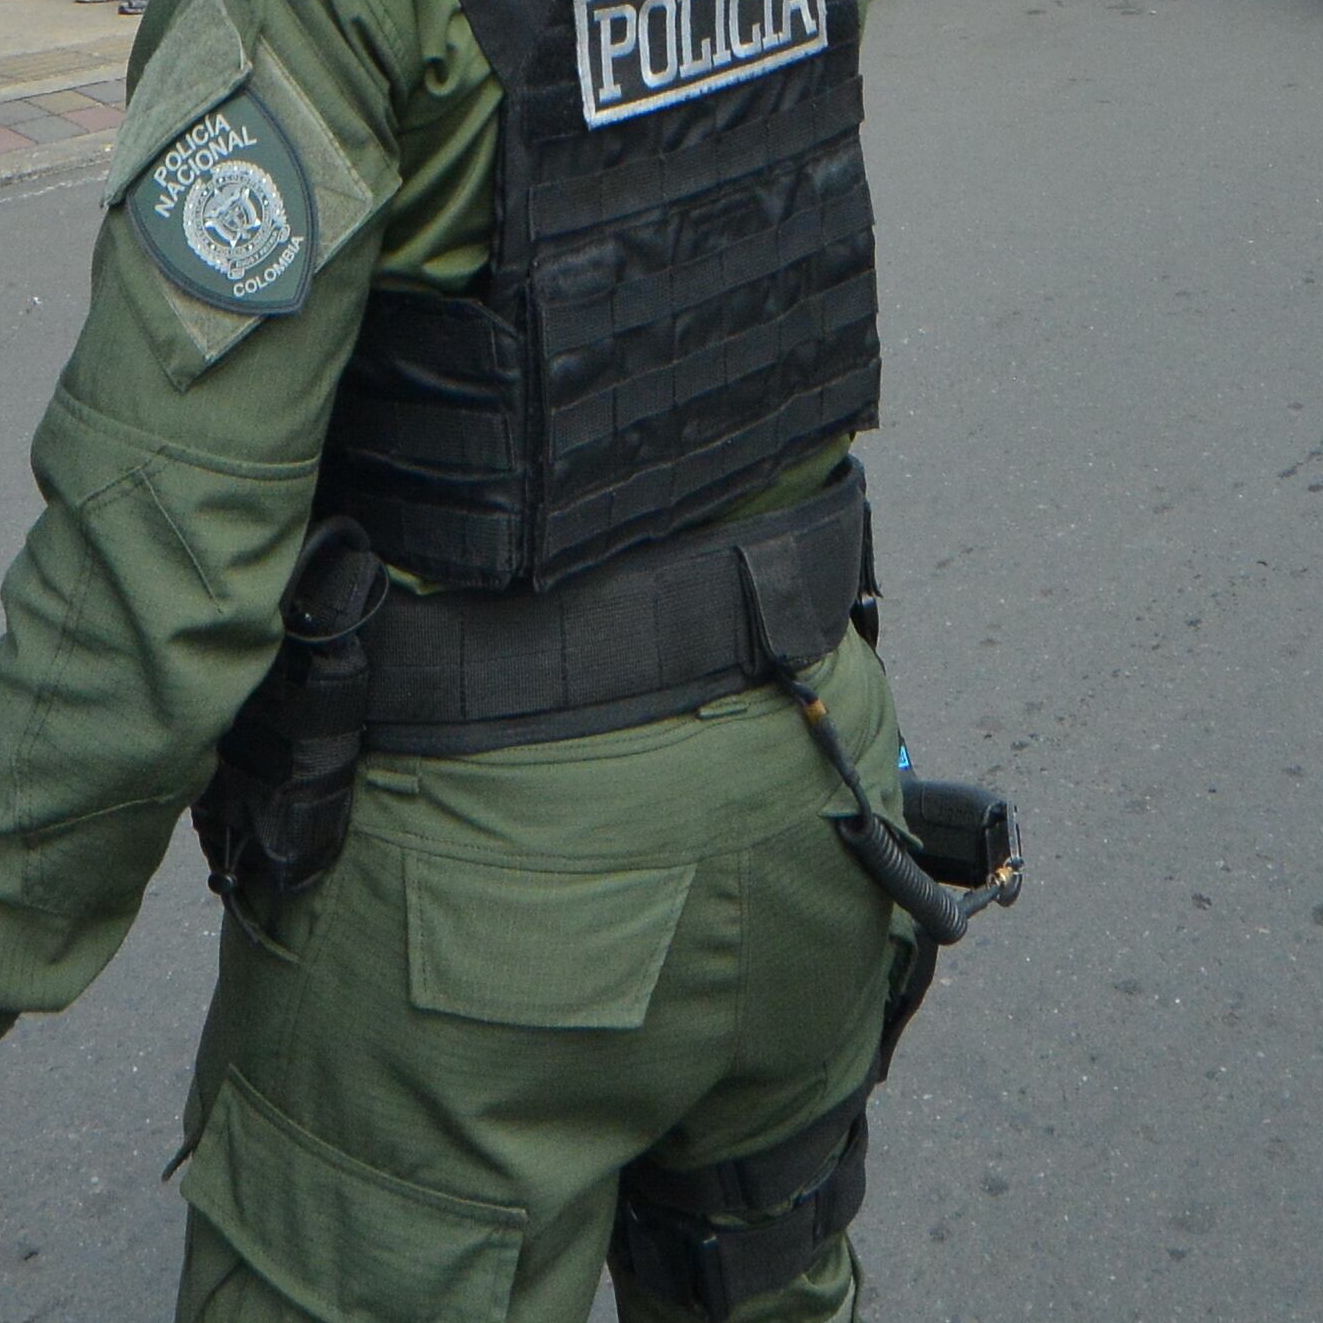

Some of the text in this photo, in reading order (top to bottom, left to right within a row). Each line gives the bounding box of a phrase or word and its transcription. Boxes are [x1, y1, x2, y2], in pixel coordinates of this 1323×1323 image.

[153, 113, 232, 189] POLICÍA
[154, 126, 258, 218] NACIONAL
[233, 235, 305, 297] COLOMBIA
